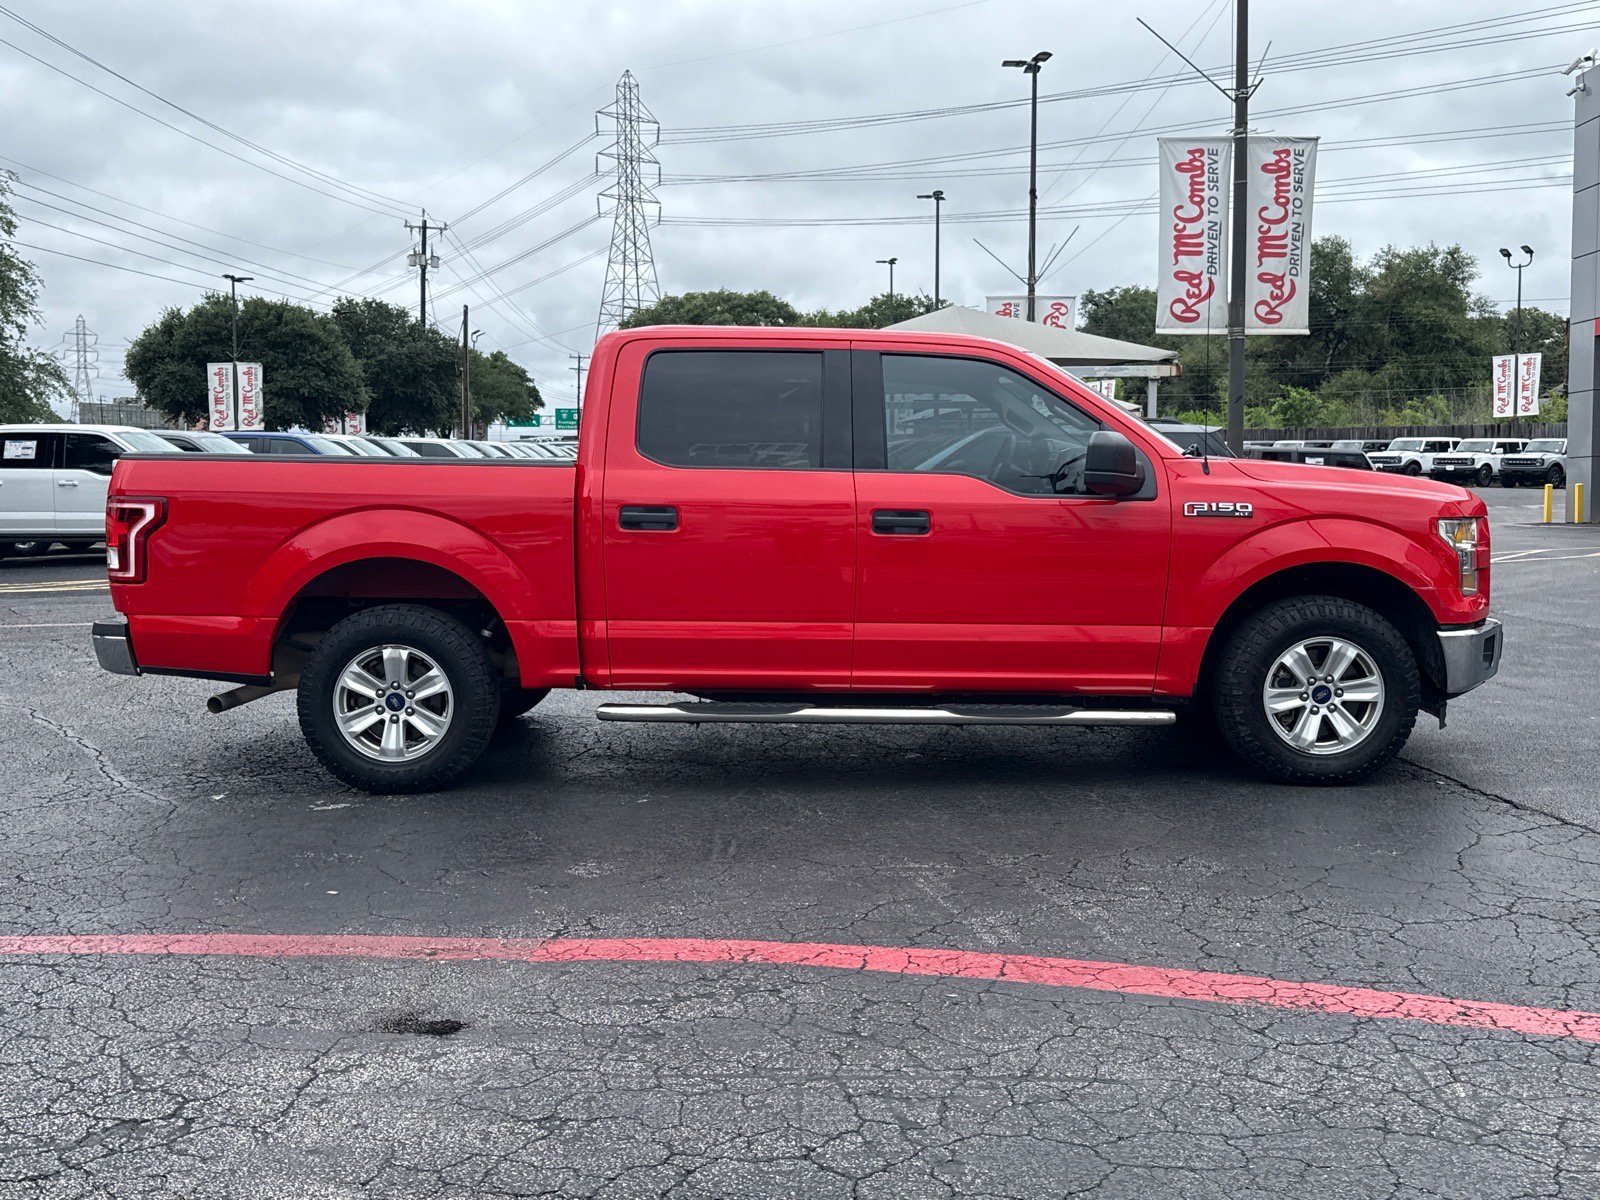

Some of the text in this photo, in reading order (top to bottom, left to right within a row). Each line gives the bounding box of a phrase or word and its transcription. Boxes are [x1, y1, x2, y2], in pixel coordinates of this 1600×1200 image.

[1170, 148, 1215, 323] Red McCombs
[1207, 148, 1219, 276] DRIVEN TO SERVE
[1254, 148, 1296, 325] Red McCombs
[1289, 148, 1304, 277] DRIVEN TO SERVE
[213, 367, 229, 427] Red McCombs
[242, 366, 258, 427] Red McCombs
[1497, 359, 1509, 413] Red McCombs
[1521, 357, 1534, 412] Red McCombs
